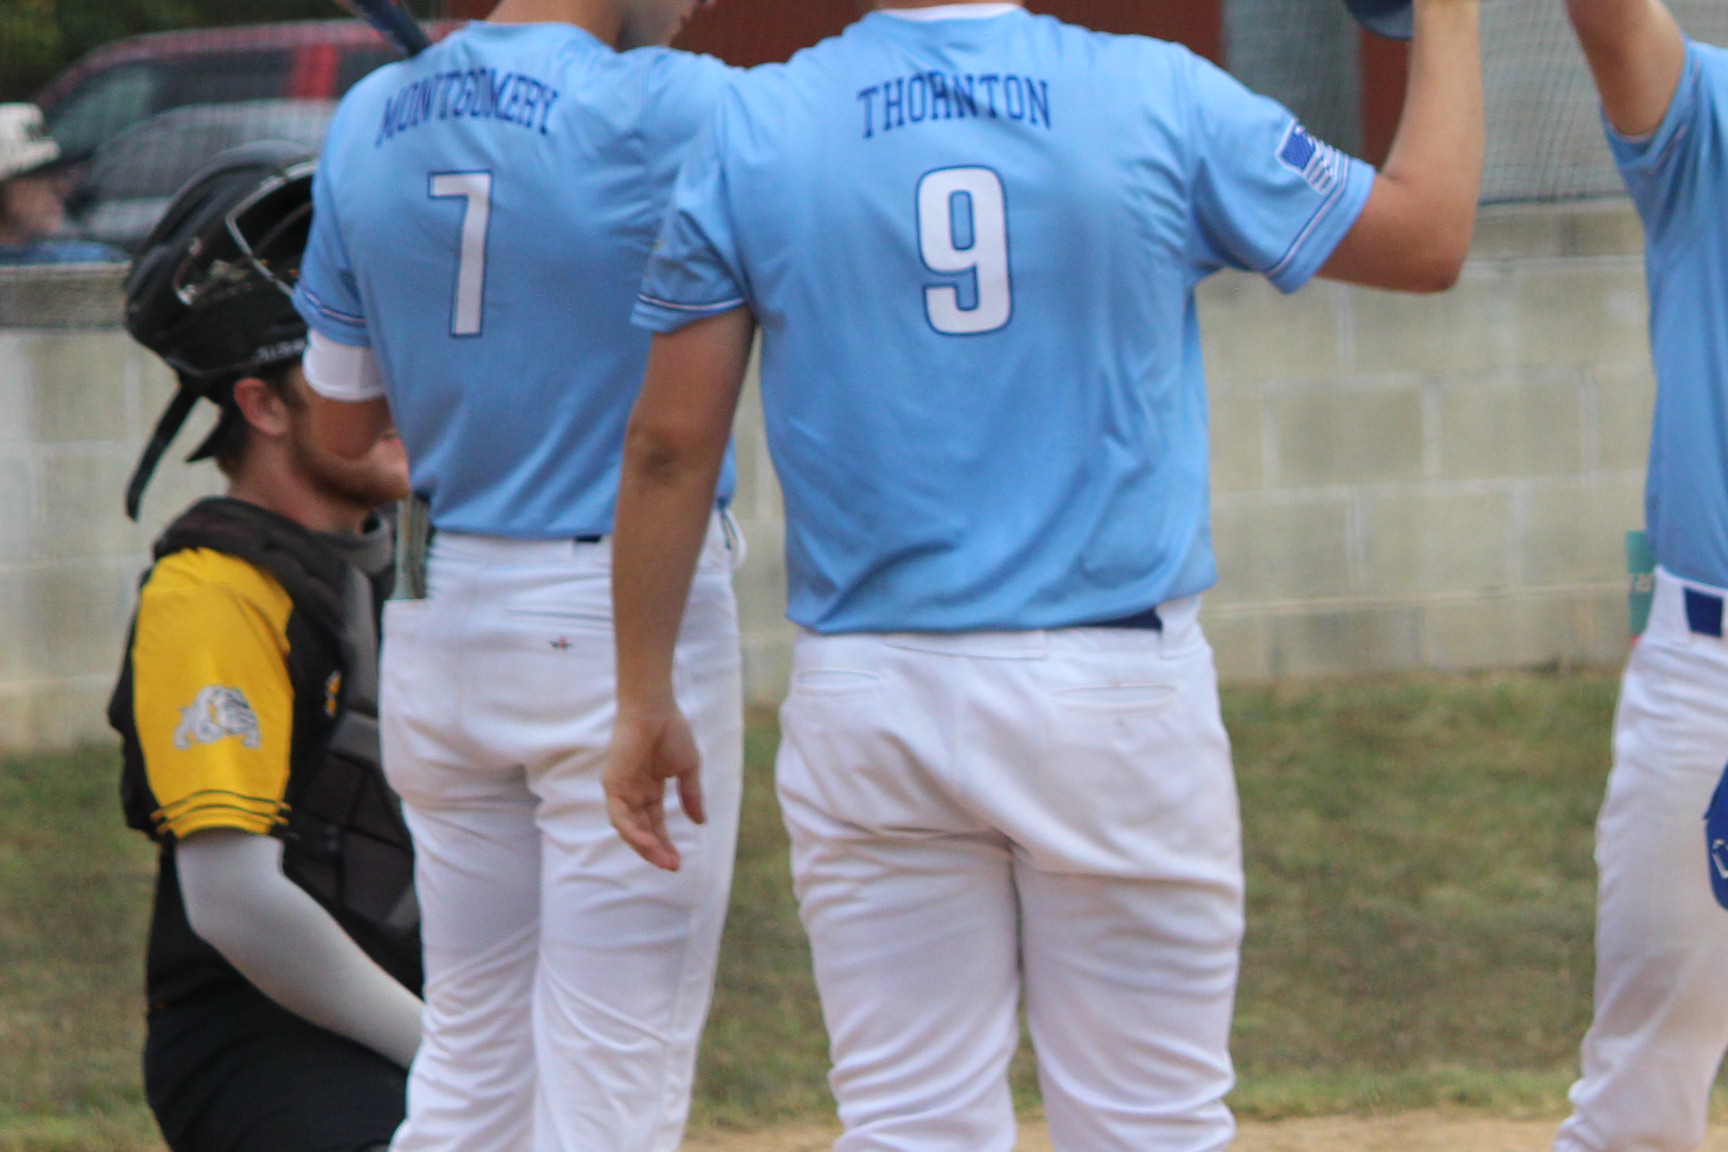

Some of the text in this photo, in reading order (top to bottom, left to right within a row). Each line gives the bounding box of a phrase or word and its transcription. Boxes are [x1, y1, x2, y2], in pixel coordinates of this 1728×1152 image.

[375, 65, 559, 147] MONTGOMERY
[857, 70, 1052, 139] THORNTON
[427, 169, 494, 339] 7
[915, 164, 1014, 337] 9
